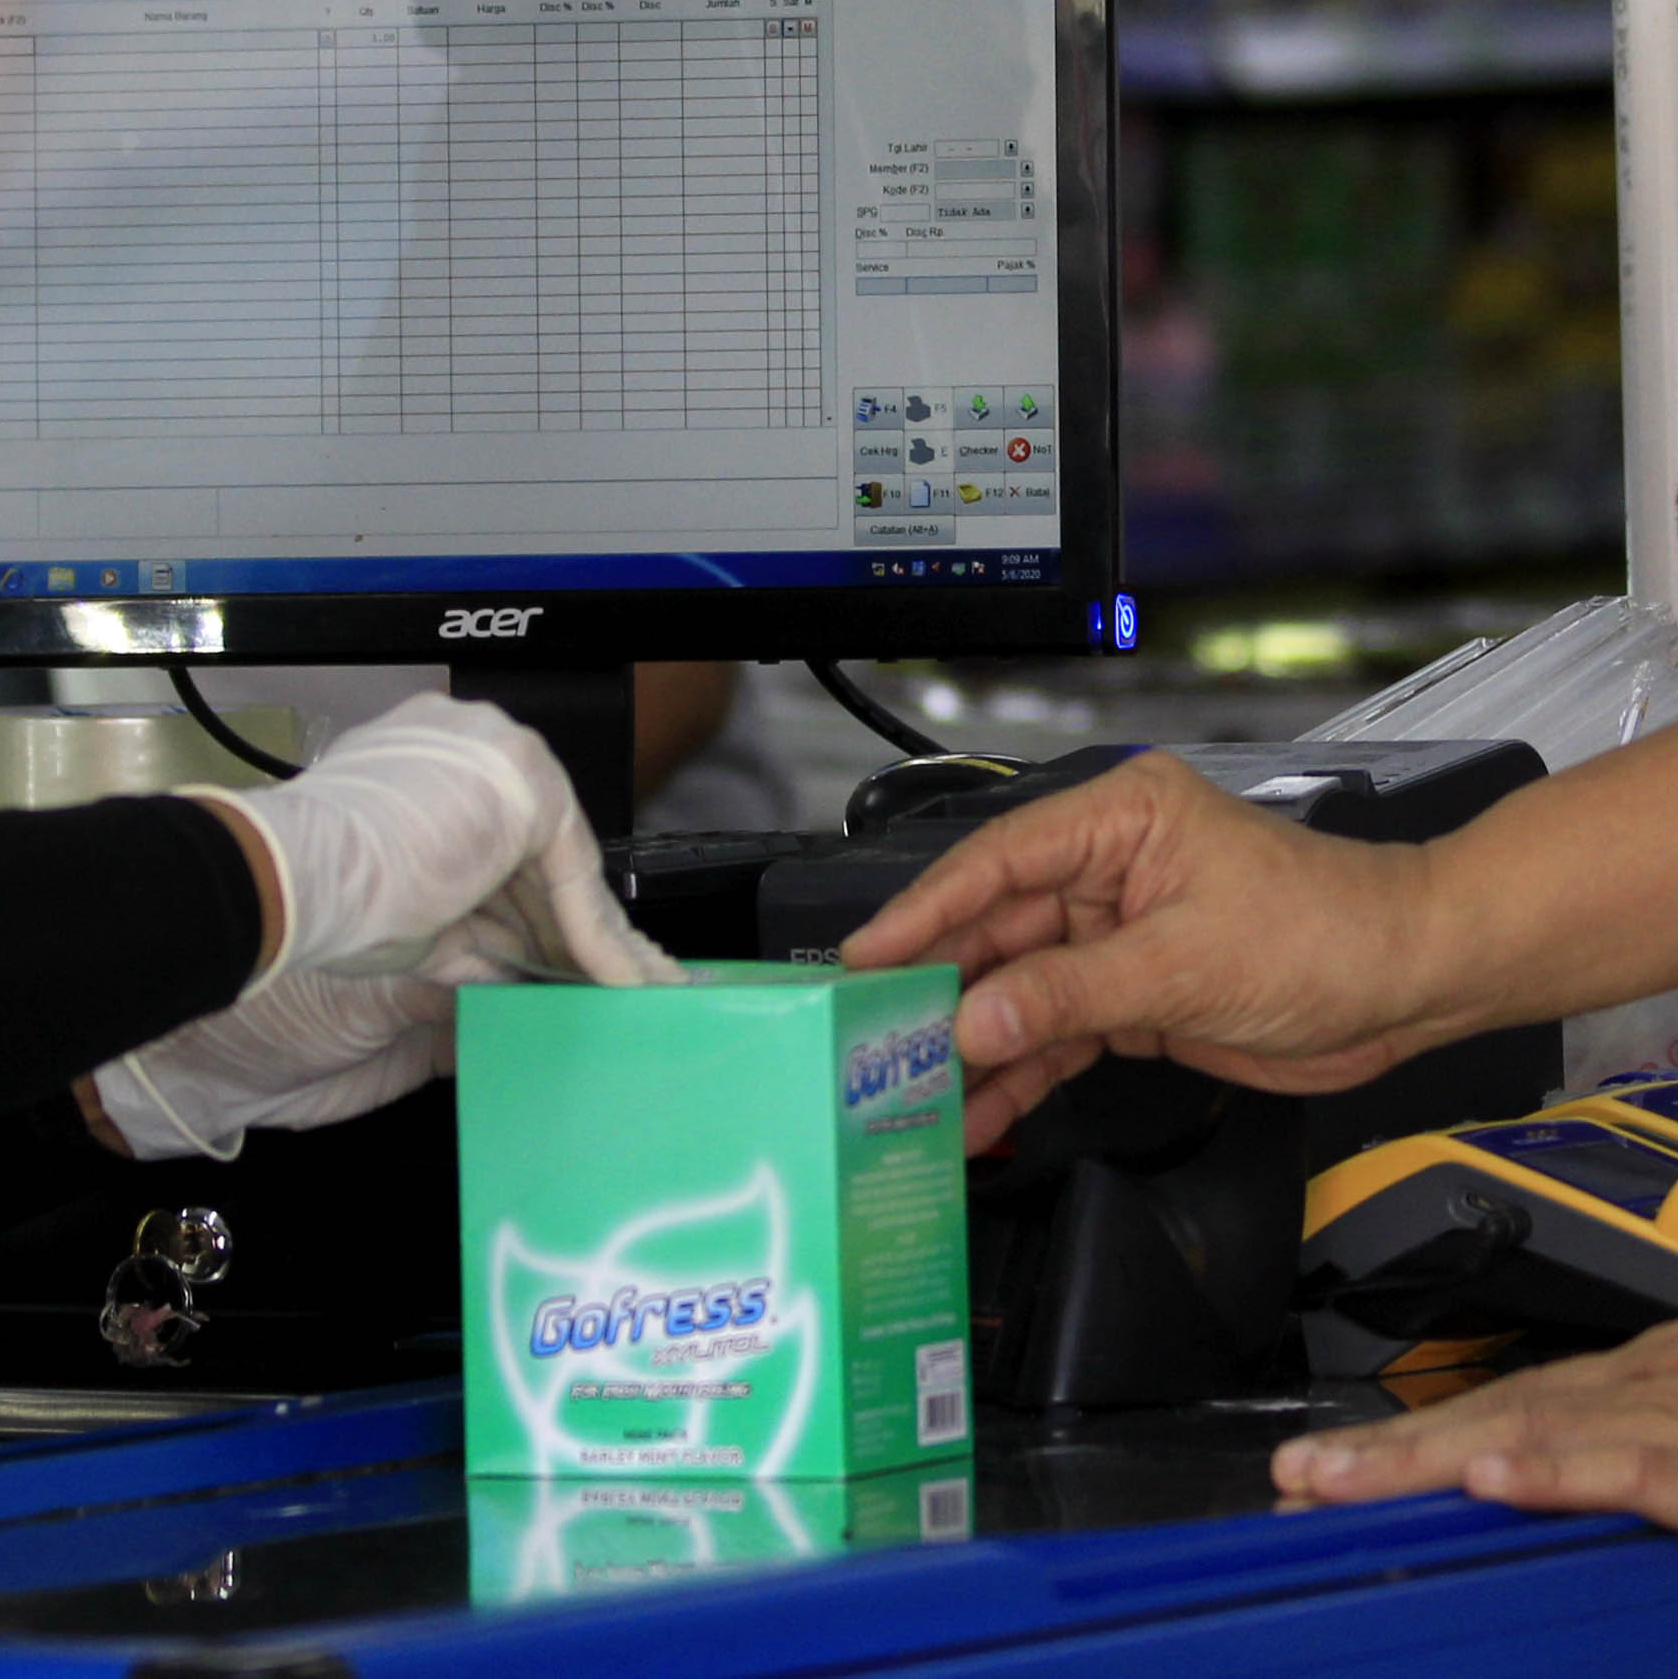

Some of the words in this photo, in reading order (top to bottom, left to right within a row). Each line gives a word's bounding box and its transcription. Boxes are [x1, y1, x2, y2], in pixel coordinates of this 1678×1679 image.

[477, 3, 506, 16] Harga
[539, 2, 561, 13] Disc
[581, 1, 603, 12] Disc
[639, 0, 662, 10] Disc
[870, 164, 907, 175] Member
[909, 163, 929, 174] (F2)
[883, 185, 908, 196] Kode
[909, 184, 929, 195] (F2)
[855, 263, 889, 272] Service
[884, 404, 897, 414] F4
[959, 446, 998, 457] Checker
[883, 489, 901, 499] F10
[933, 489, 950, 499] F11
[985, 488, 1004, 498] F12
[1001, 554, 1021, 564] 9:09
[1023, 553, 1040, 564] AM
[438, 606, 546, 640] acer
[651, 1333, 770, 1368] XYLITOL
